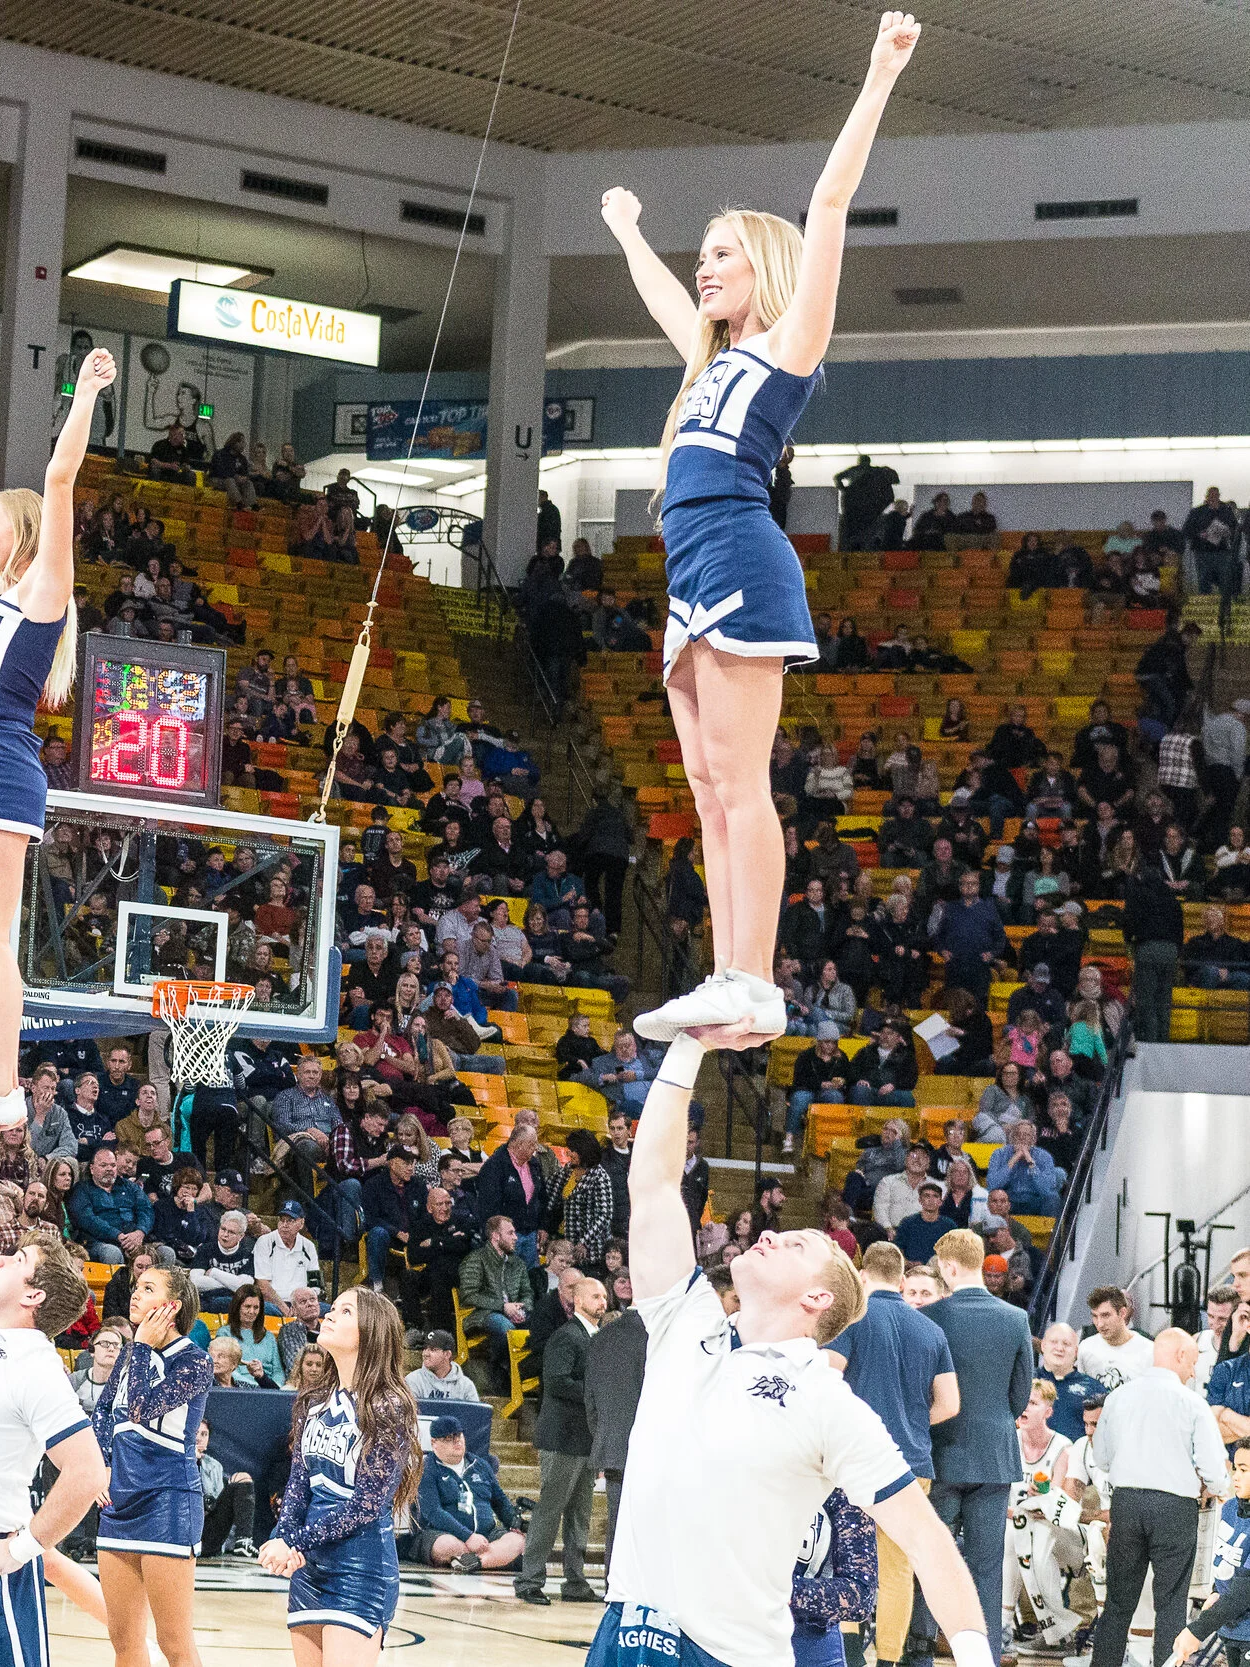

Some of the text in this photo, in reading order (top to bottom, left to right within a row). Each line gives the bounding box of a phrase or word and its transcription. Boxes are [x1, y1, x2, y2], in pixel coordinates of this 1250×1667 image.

[29, 344, 46, 370] T
[514, 424, 532, 449] U
[110, 711, 187, 787] 20
[618, 1629, 677, 1657] AGGIES
